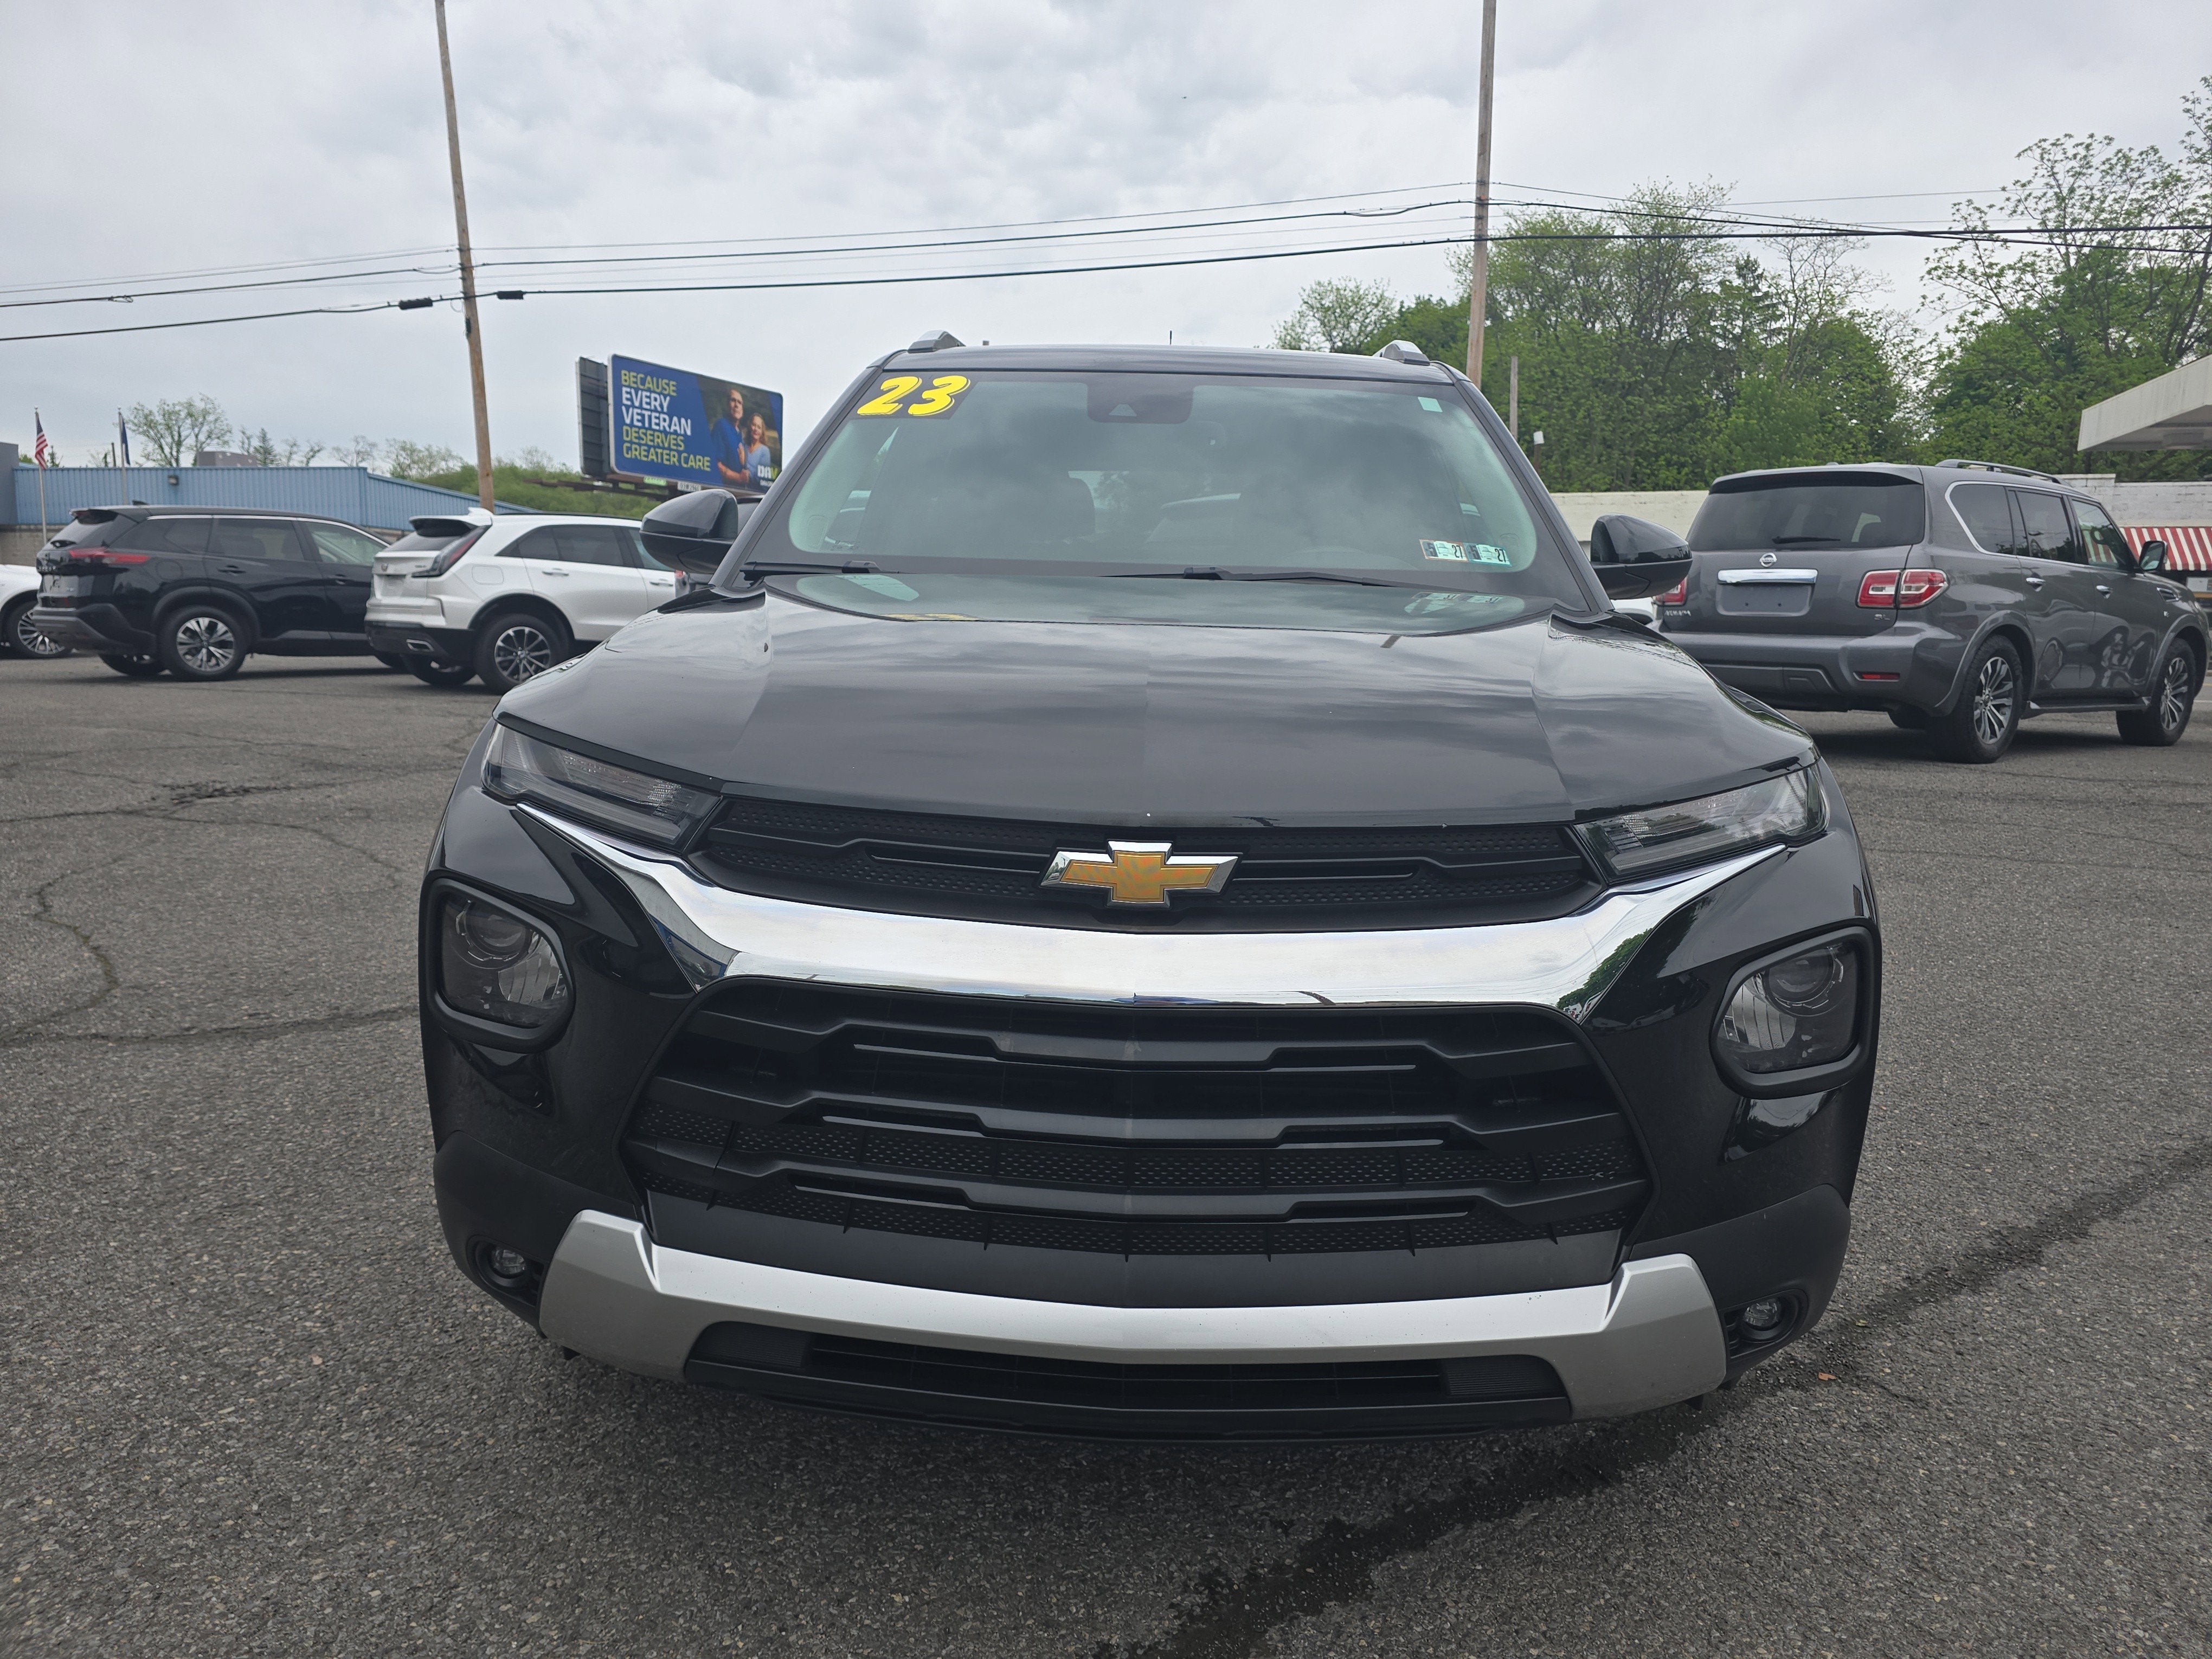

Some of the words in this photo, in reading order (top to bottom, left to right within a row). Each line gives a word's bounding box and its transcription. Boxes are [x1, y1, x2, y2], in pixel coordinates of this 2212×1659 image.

[621, 370, 677, 396] BECAUSE
[857, 375, 971, 416] 23
[622, 387, 670, 413] EVERY
[622, 406, 692, 436] VETERAN
[623, 425, 685, 451] DESERVES
[623, 442, 679, 466] GREATER
[681, 453, 711, 472] CARE
[757, 465, 779, 480] DAV
[1451, 544, 1463, 559] 27
[1494, 548, 1506, 563] 27
